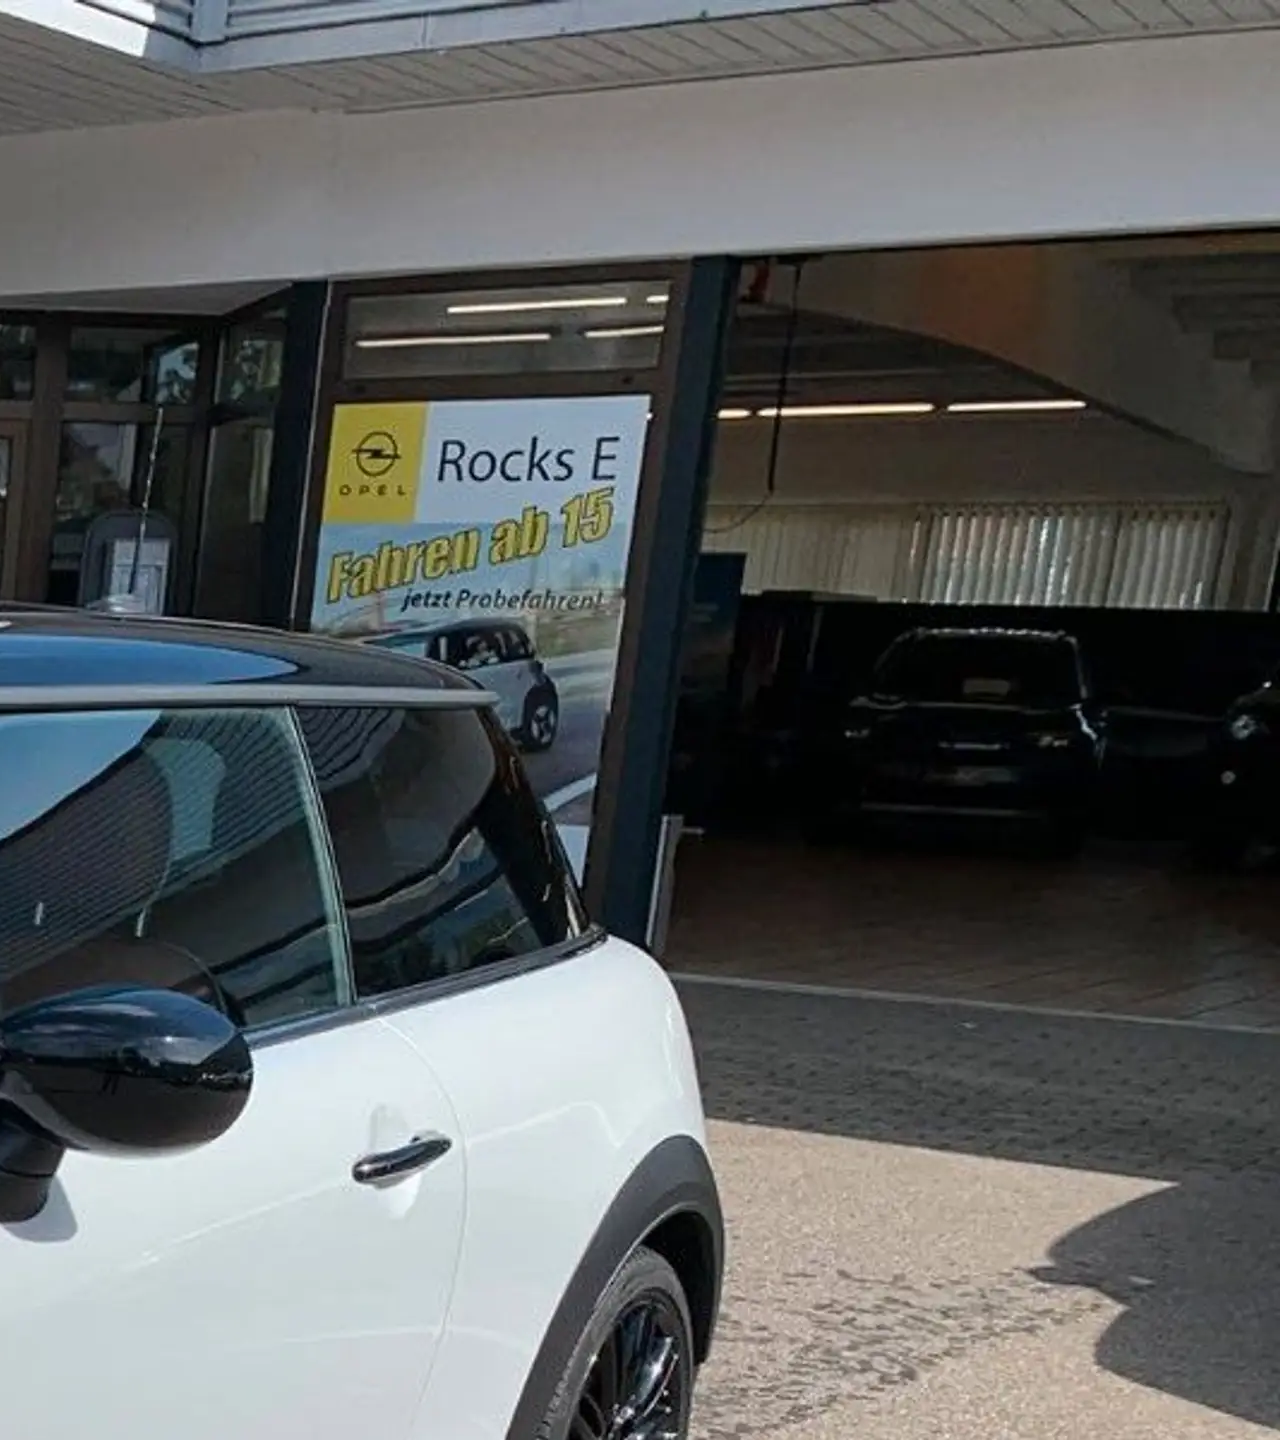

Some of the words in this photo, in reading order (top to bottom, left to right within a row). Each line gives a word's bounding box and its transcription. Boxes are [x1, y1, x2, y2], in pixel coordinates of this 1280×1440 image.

[438, 436, 575, 482] Rocks
[592, 436, 621, 481] E
[339, 484, 407, 497] OPEL
[326, 526, 481, 604] Fahren
[488, 504, 550, 566] ab
[560, 486, 615, 549] 15
[400, 588, 452, 613] jetzt
[456, 588, 604, 613] Probefahren!
